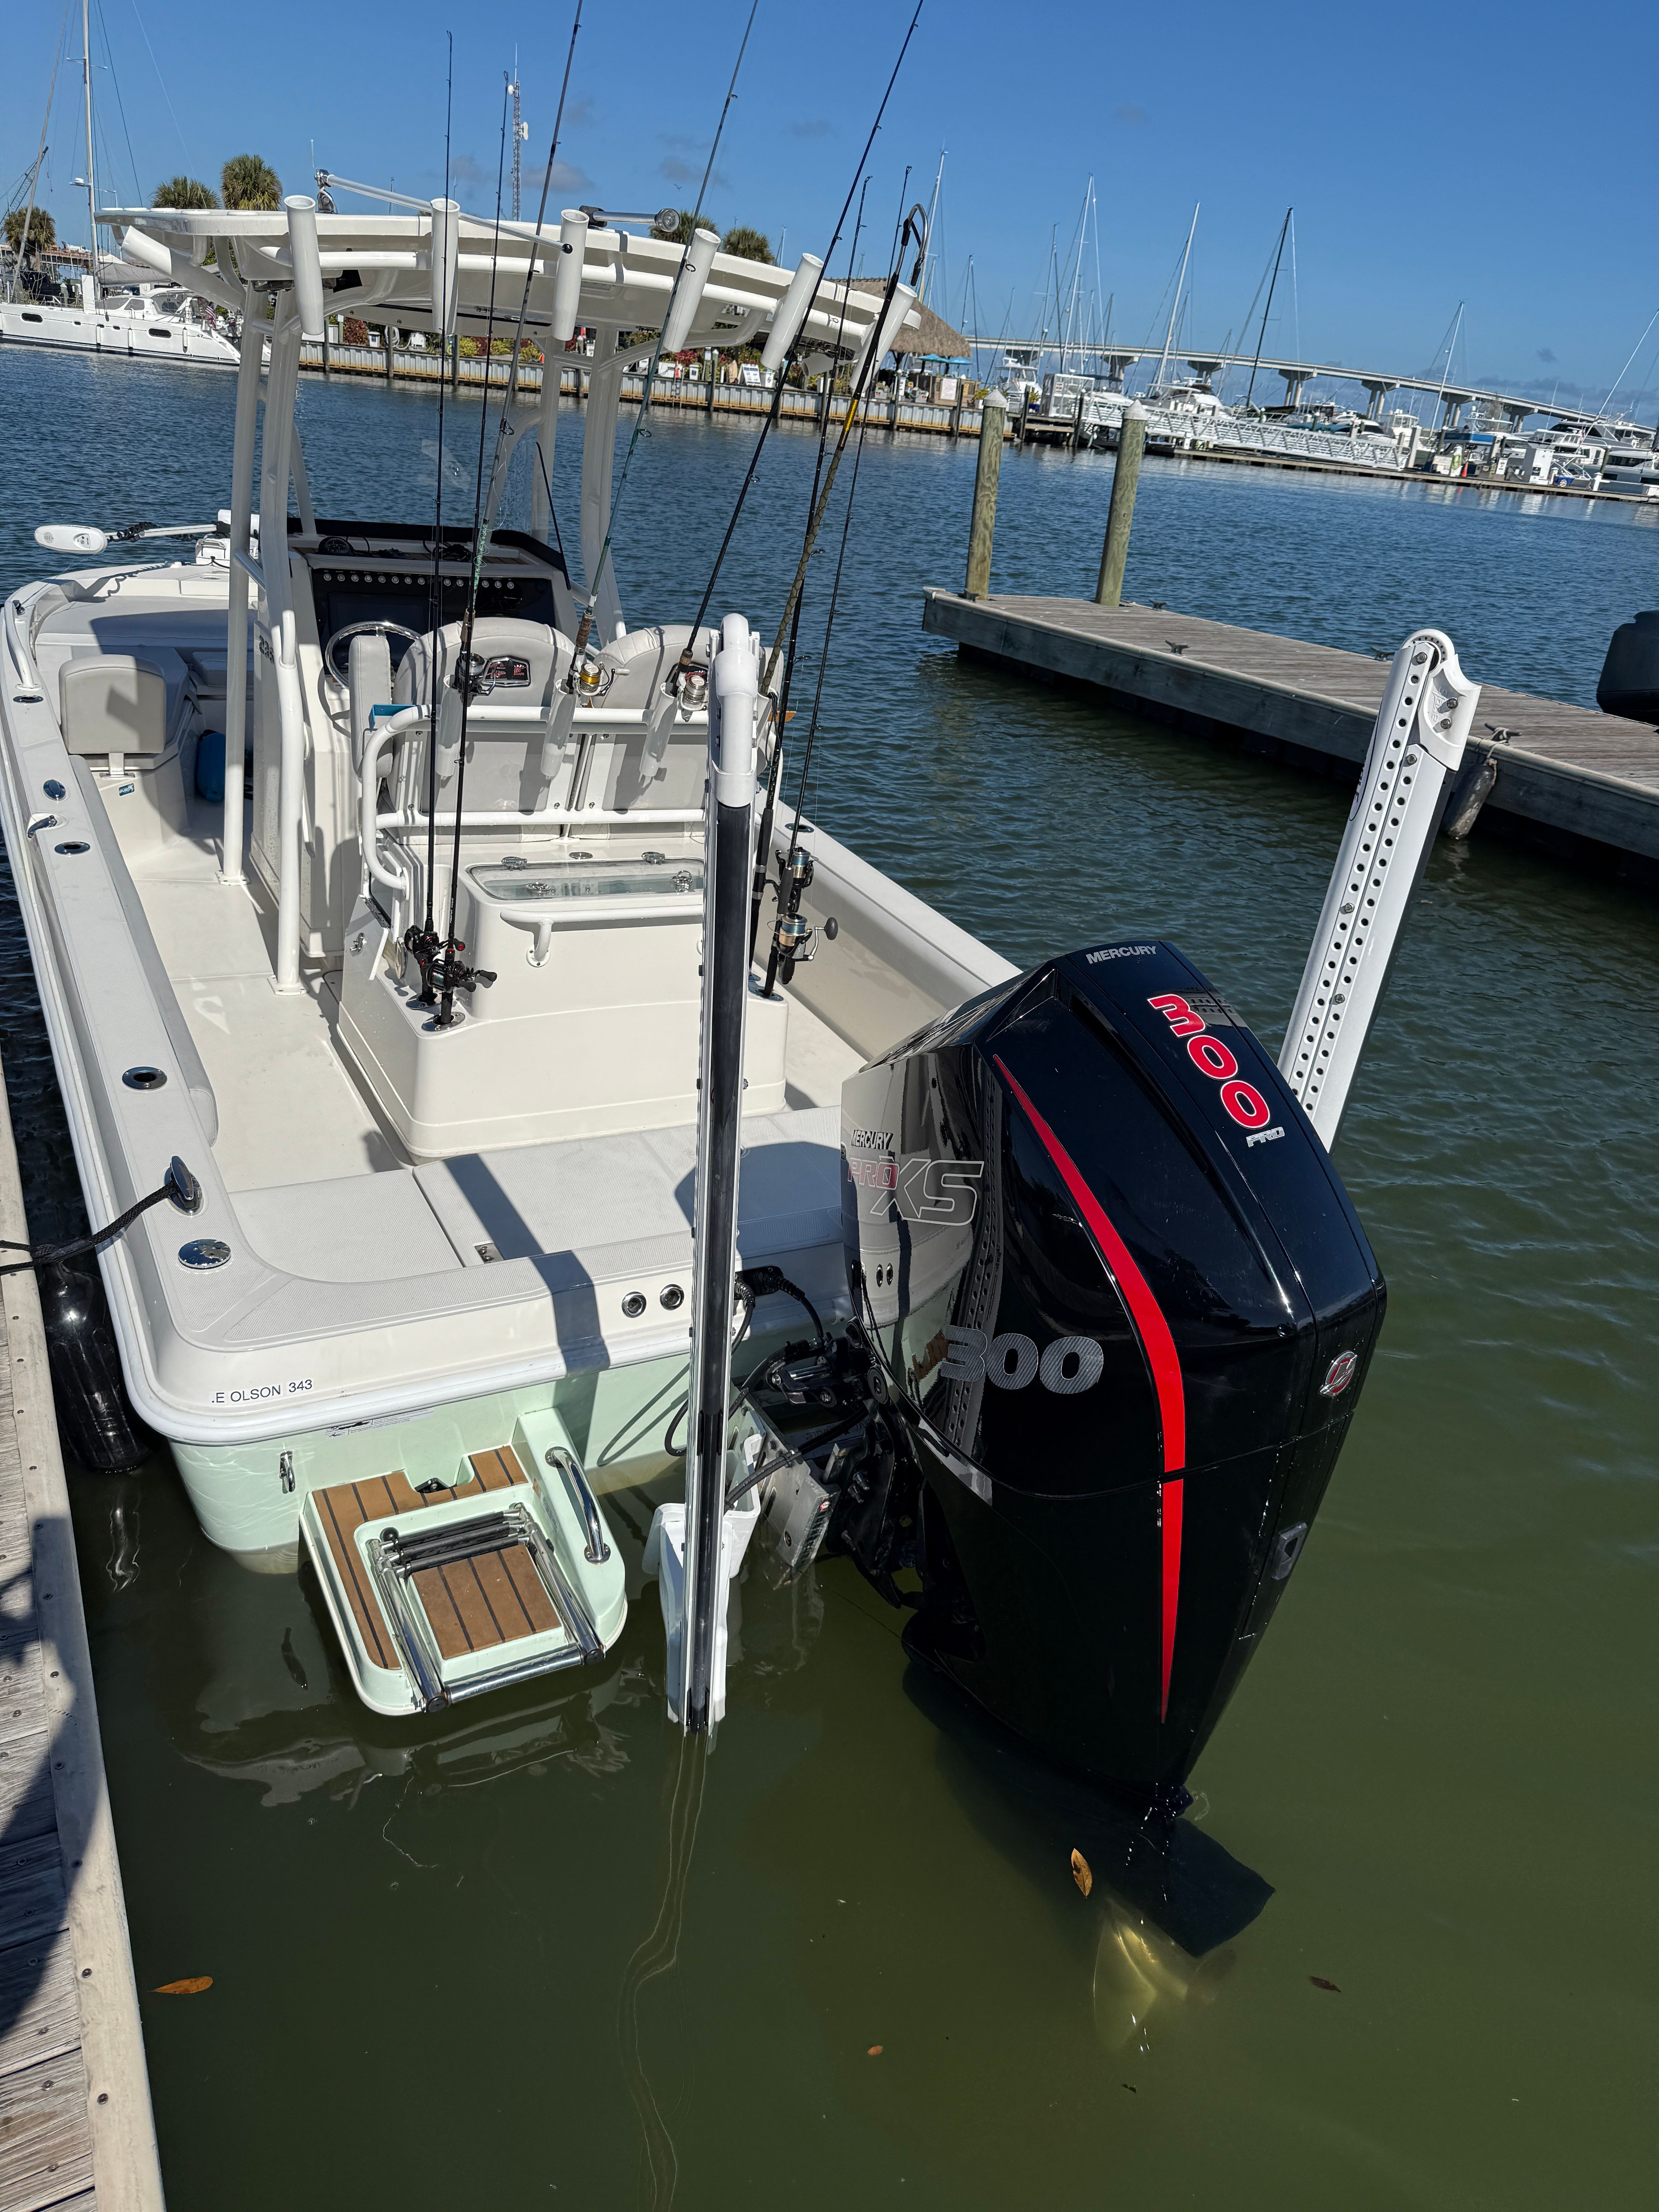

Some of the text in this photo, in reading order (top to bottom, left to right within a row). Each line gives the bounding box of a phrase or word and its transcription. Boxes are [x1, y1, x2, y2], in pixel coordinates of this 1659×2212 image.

[1085, 946, 1156, 964] MERCURY
[1146, 993, 1271, 1129] 300
[852, 1129, 893, 1150] MERCURY
[1246, 1126, 1285, 1147] PRO
[847, 1157, 900, 1191] PRO
[940, 1324, 1104, 1394] 300
[230, 1384, 281, 1402] OLSON
[289, 1379, 313, 1393] 343
